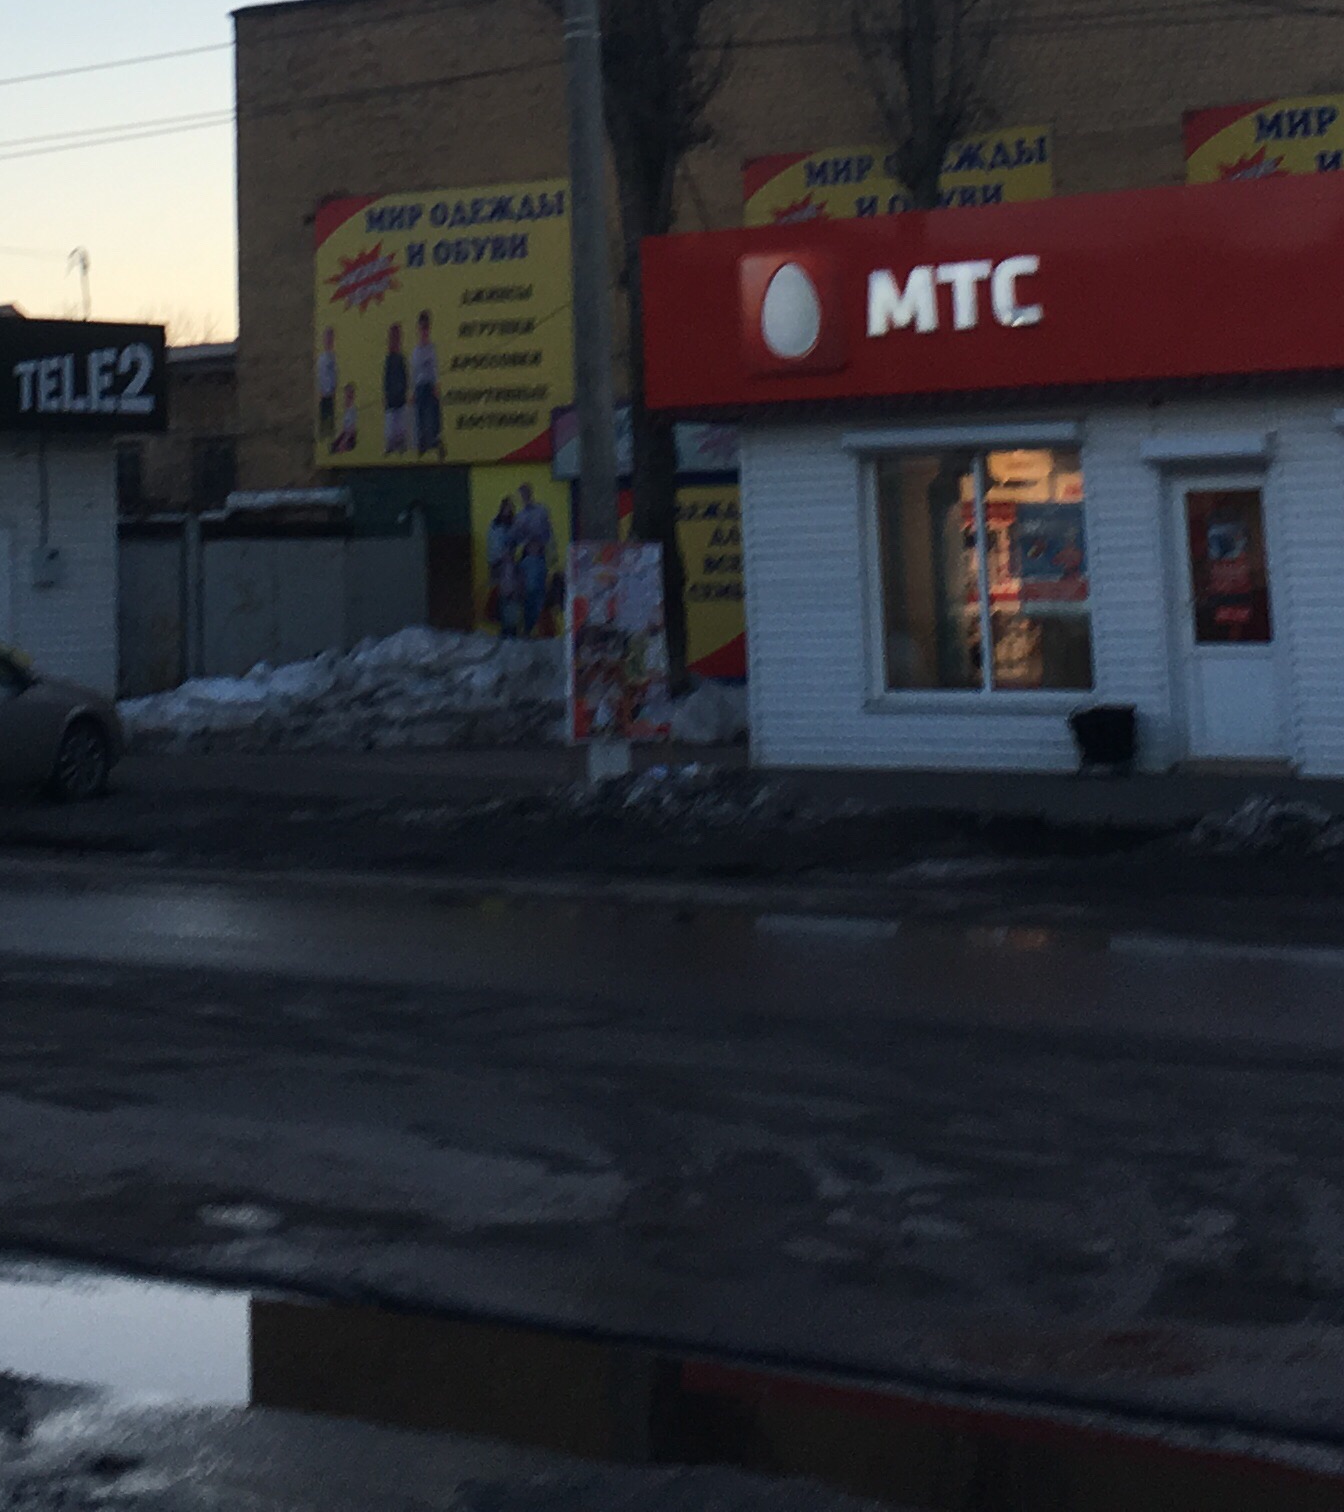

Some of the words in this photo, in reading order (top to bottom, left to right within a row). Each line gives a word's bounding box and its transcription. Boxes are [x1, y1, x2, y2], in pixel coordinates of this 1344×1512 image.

[1254, 105, 1338, 143] МИР
[804, 154, 873, 188] МИР
[365, 202, 424, 233] МИР
[430, 190, 565, 228] ОДЕЖДЫ
[406, 242, 426, 268] И
[433, 232, 529, 266] ОБУВИ
[865, 255, 1043, 338] МТС
[14, 343, 157, 414] TELE2
